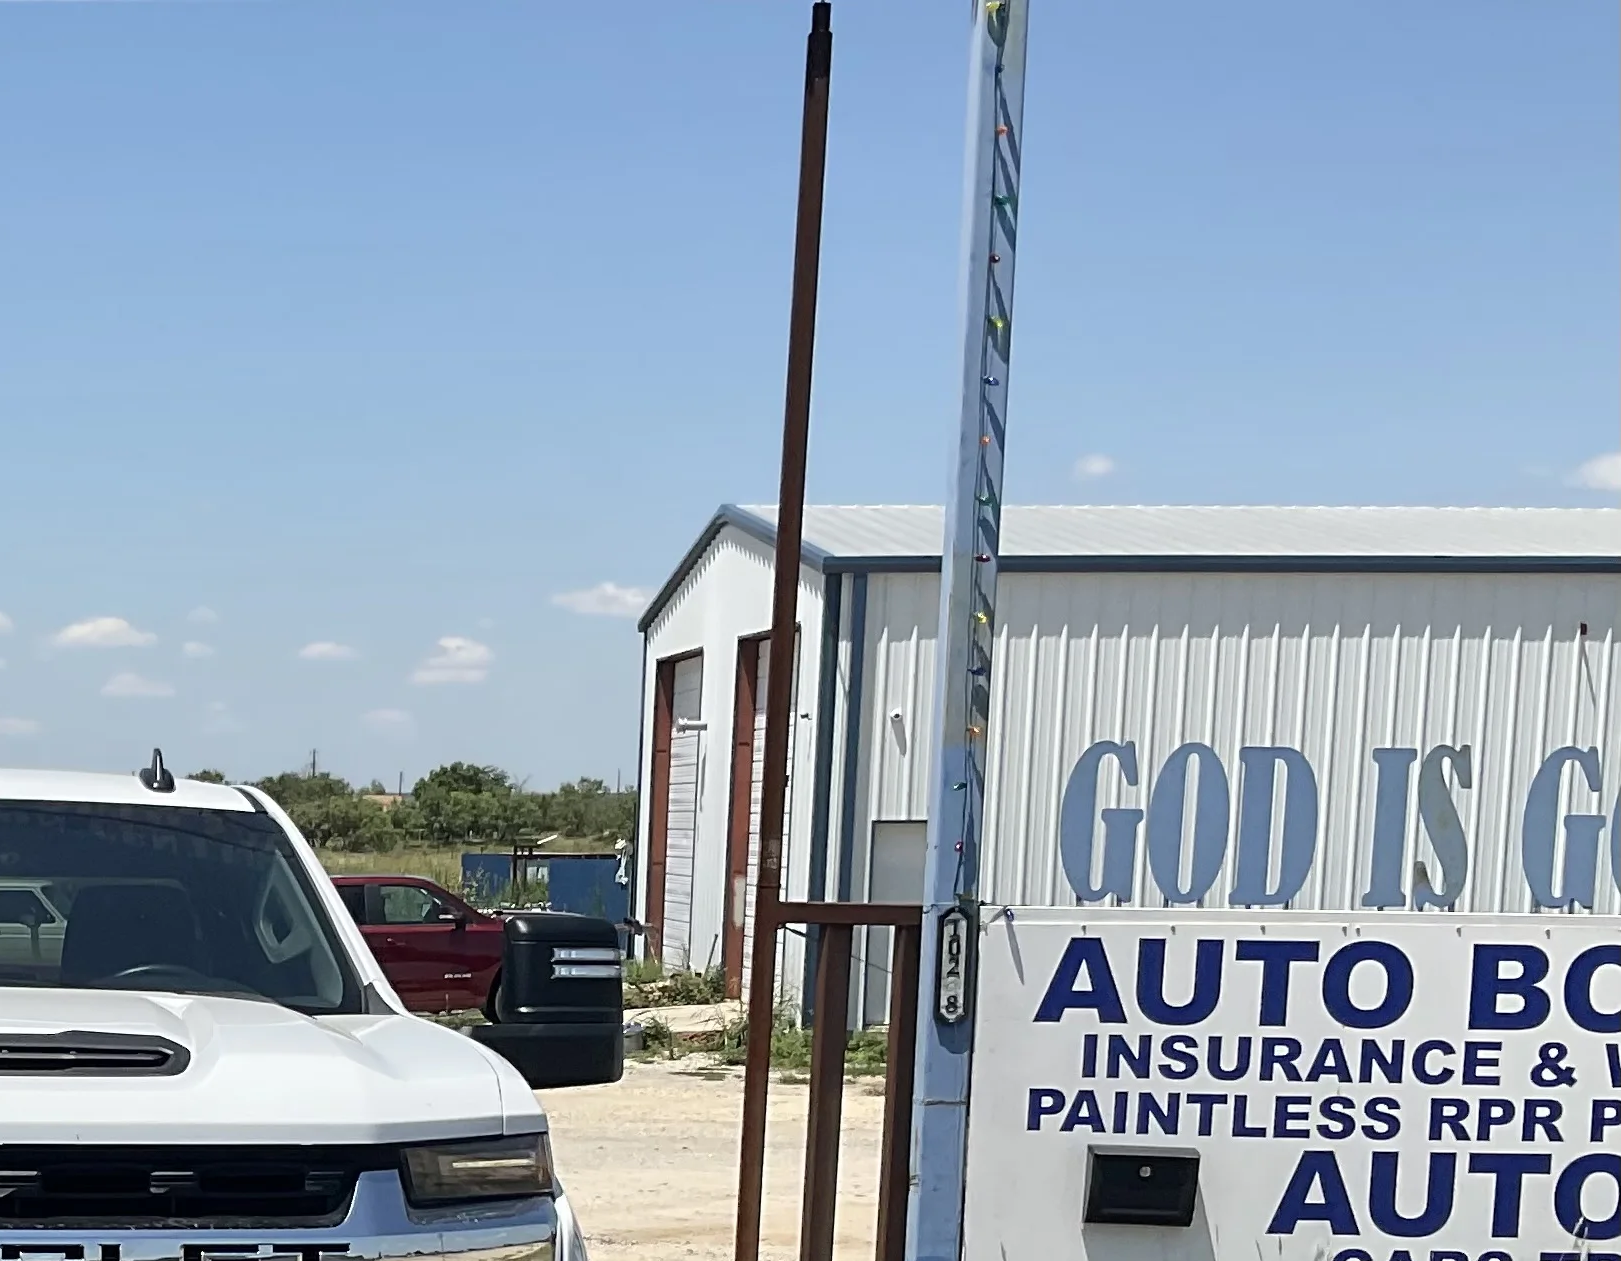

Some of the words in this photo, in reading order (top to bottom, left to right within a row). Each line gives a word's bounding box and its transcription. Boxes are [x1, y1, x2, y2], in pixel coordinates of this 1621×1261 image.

[1059, 740, 1320, 906] GOD
[1363, 744, 1472, 908] IS
[1033, 938, 1414, 1029] AUTO
[1081, 1034, 1502, 1086] INSURANCE
[1530, 1042, 1577, 1087] &
[1026, 1088, 1401, 1141] PAINTLESS
[1429, 1098, 1564, 1142] RPR
[1265, 1150, 1621, 1241] AUTO
